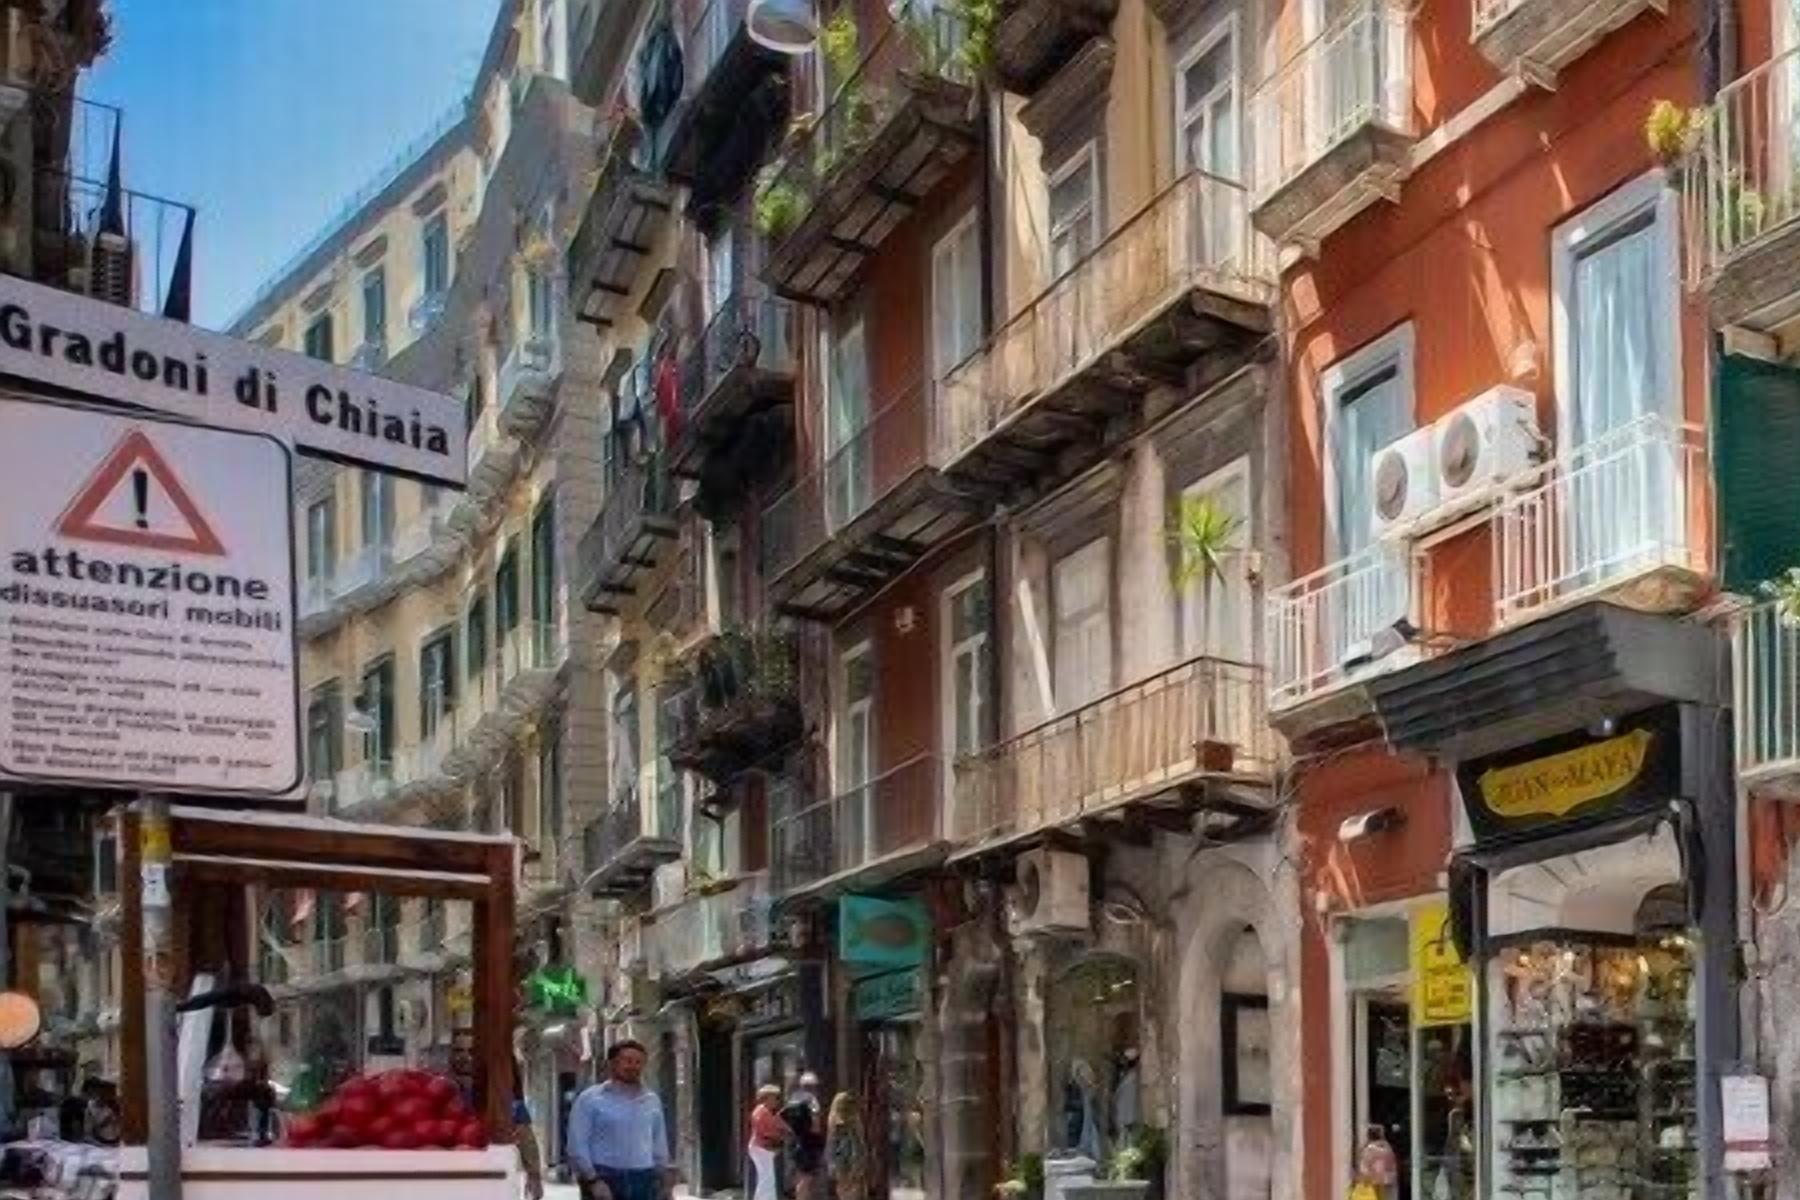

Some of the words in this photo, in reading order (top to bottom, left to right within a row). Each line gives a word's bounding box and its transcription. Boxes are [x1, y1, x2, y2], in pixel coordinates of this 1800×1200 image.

[1, 303, 208, 396] Gradoni
[234, 366, 278, 414] di
[304, 382, 450, 456] Chiaia
[12, 547, 269, 600] attenzione
[0, 583, 169, 620] dissuasori
[186, 604, 281, 632] mobili
